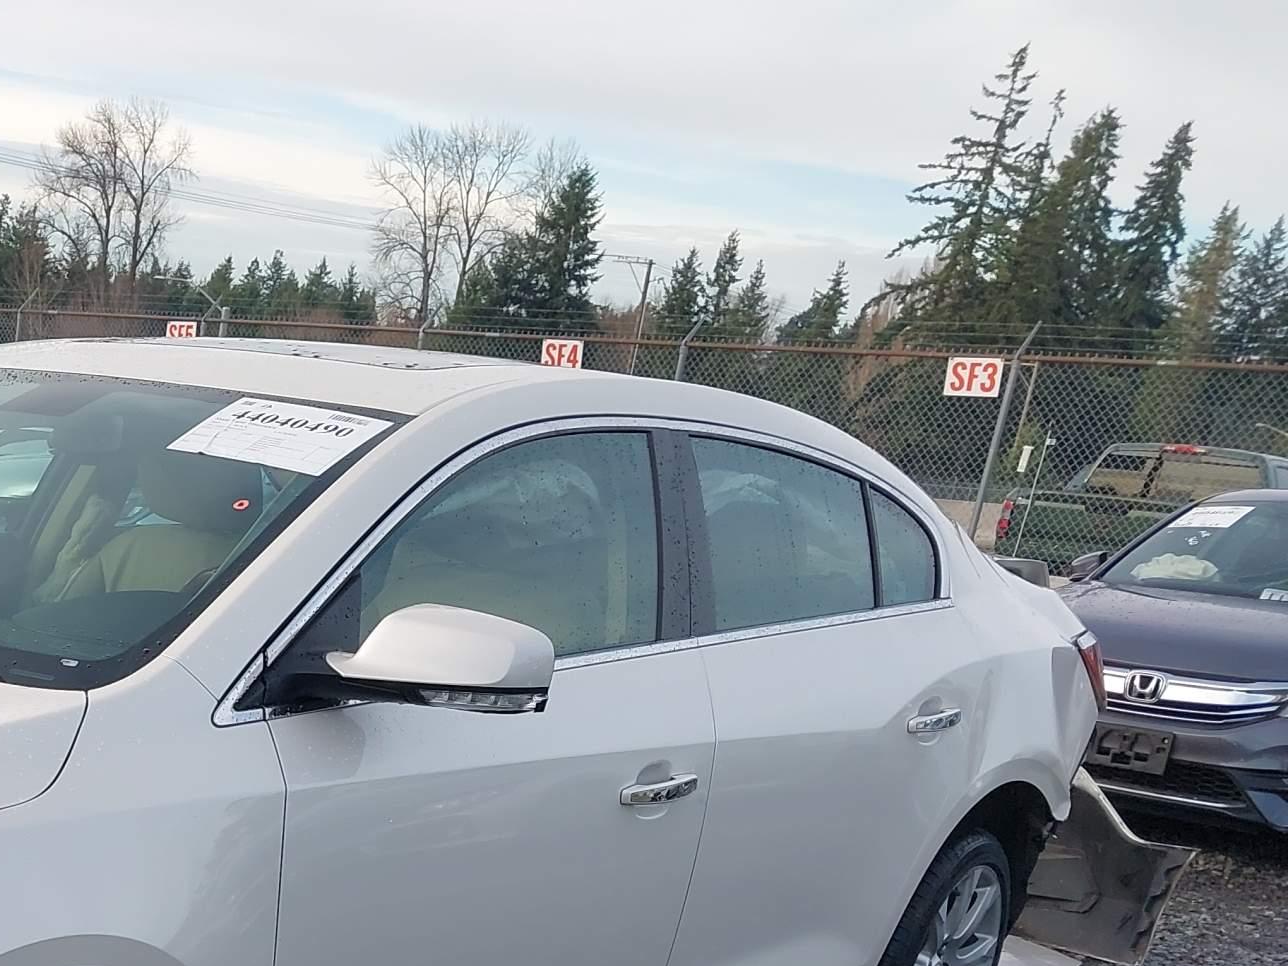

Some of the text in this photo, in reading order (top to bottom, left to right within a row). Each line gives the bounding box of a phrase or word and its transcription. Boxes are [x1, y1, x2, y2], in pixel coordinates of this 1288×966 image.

[544, 343, 579, 368] SF4
[950, 361, 998, 392] SF3
[231, 410, 355, 437] 44040490
